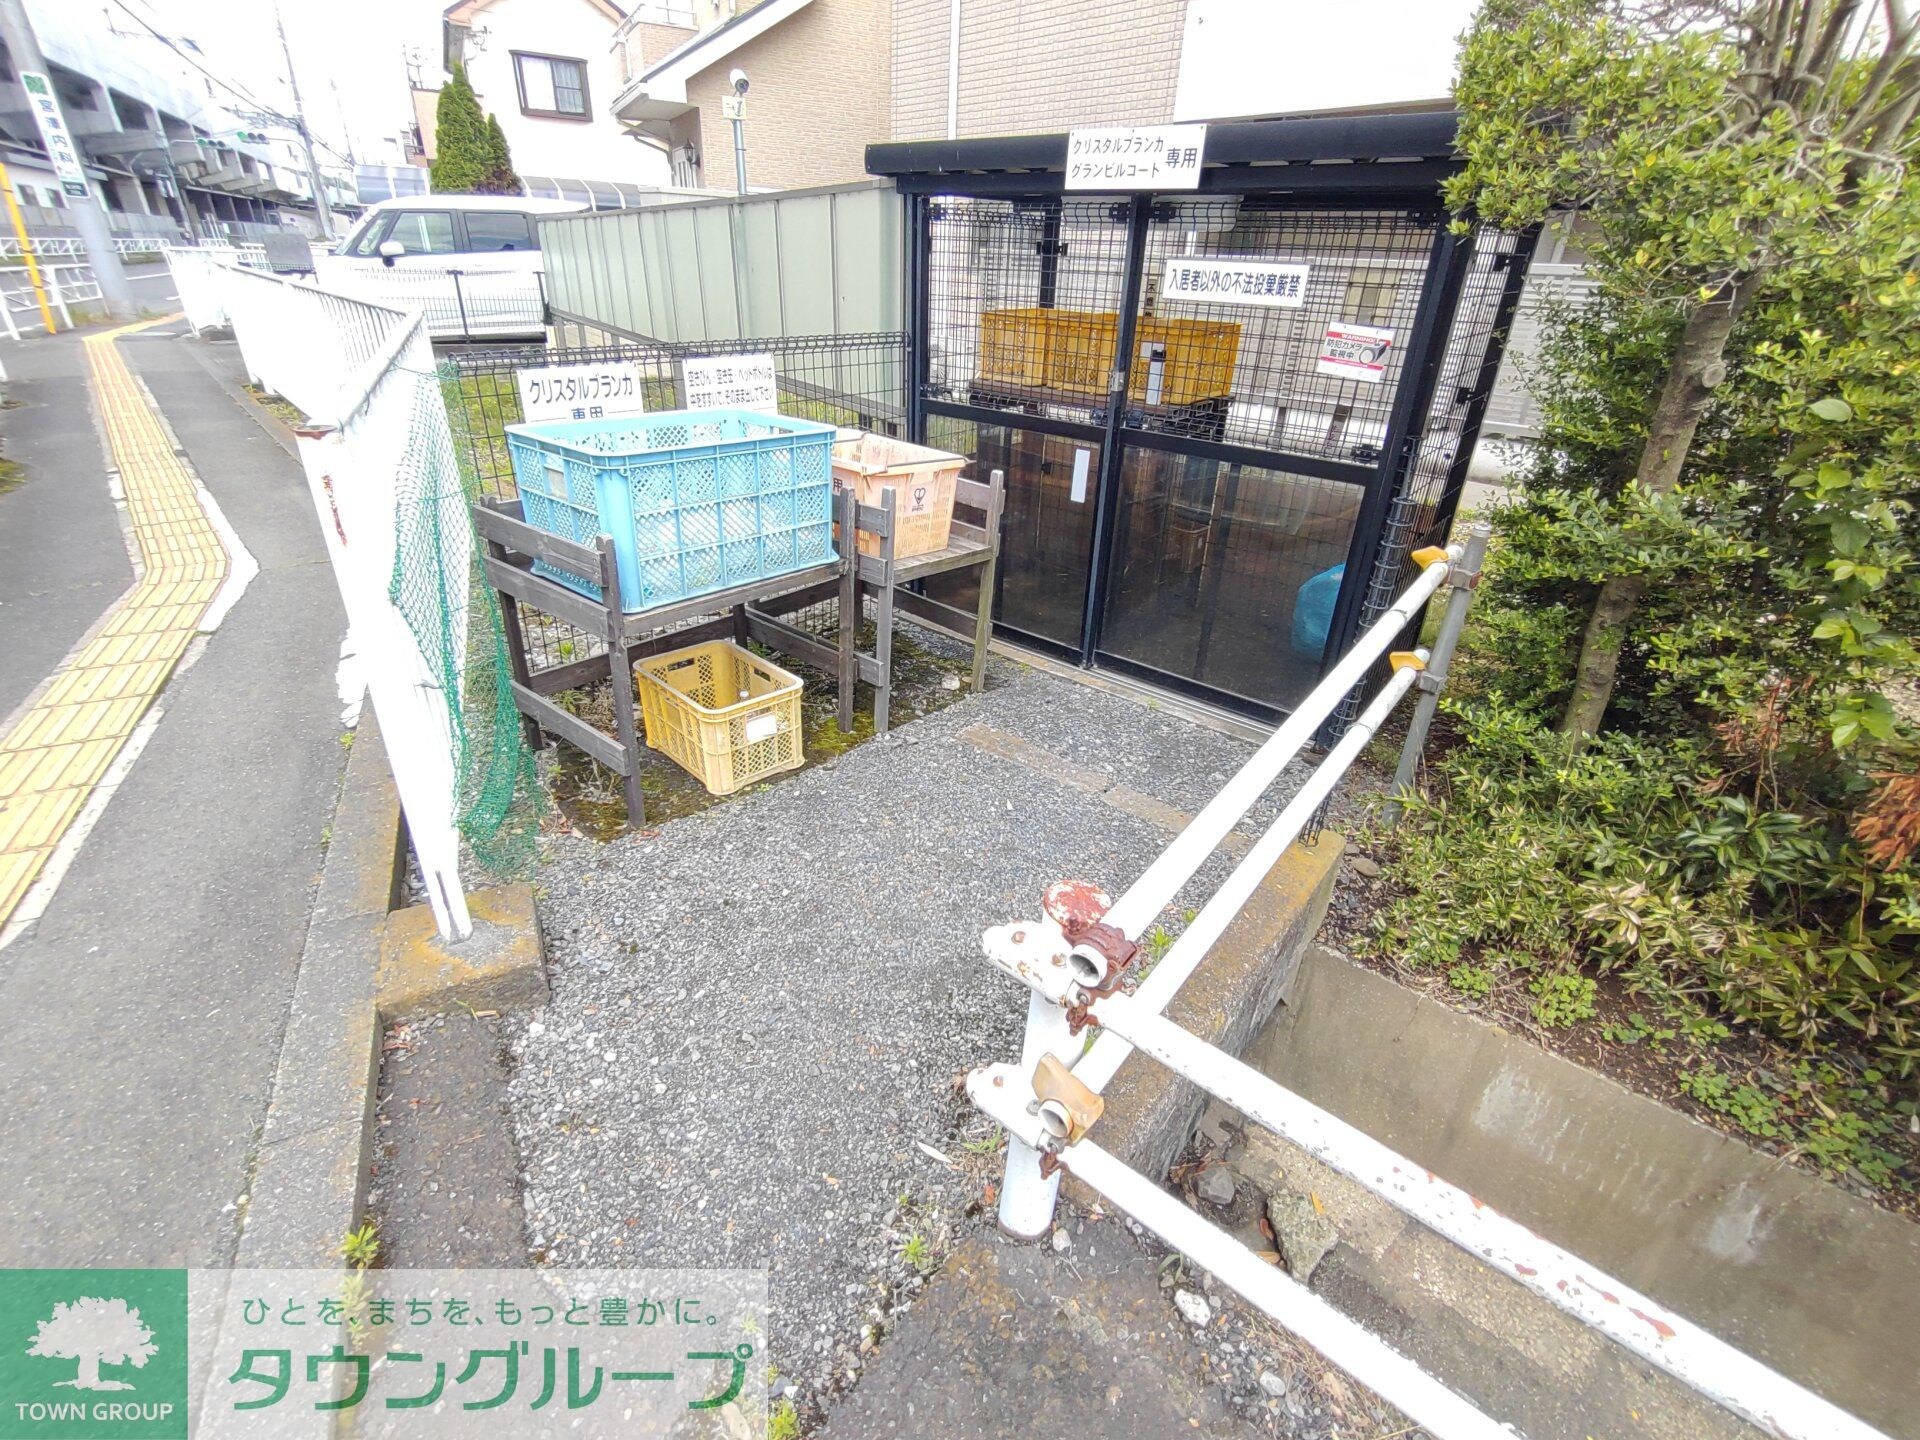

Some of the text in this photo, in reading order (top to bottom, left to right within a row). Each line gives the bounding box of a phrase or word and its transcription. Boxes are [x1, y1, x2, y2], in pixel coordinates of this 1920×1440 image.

[1072, 135, 1165, 155] クリスタルブランカ
[1165, 146, 1199, 169] 専用
[1070, 161, 1161, 179] グランビルコート
[1168, 268, 1302, 298] 入居者以外の不法投棄厳禁
[1326, 338, 1363, 352] 防犯カメラ
[529, 373, 634, 405] クリスタルブランカ
